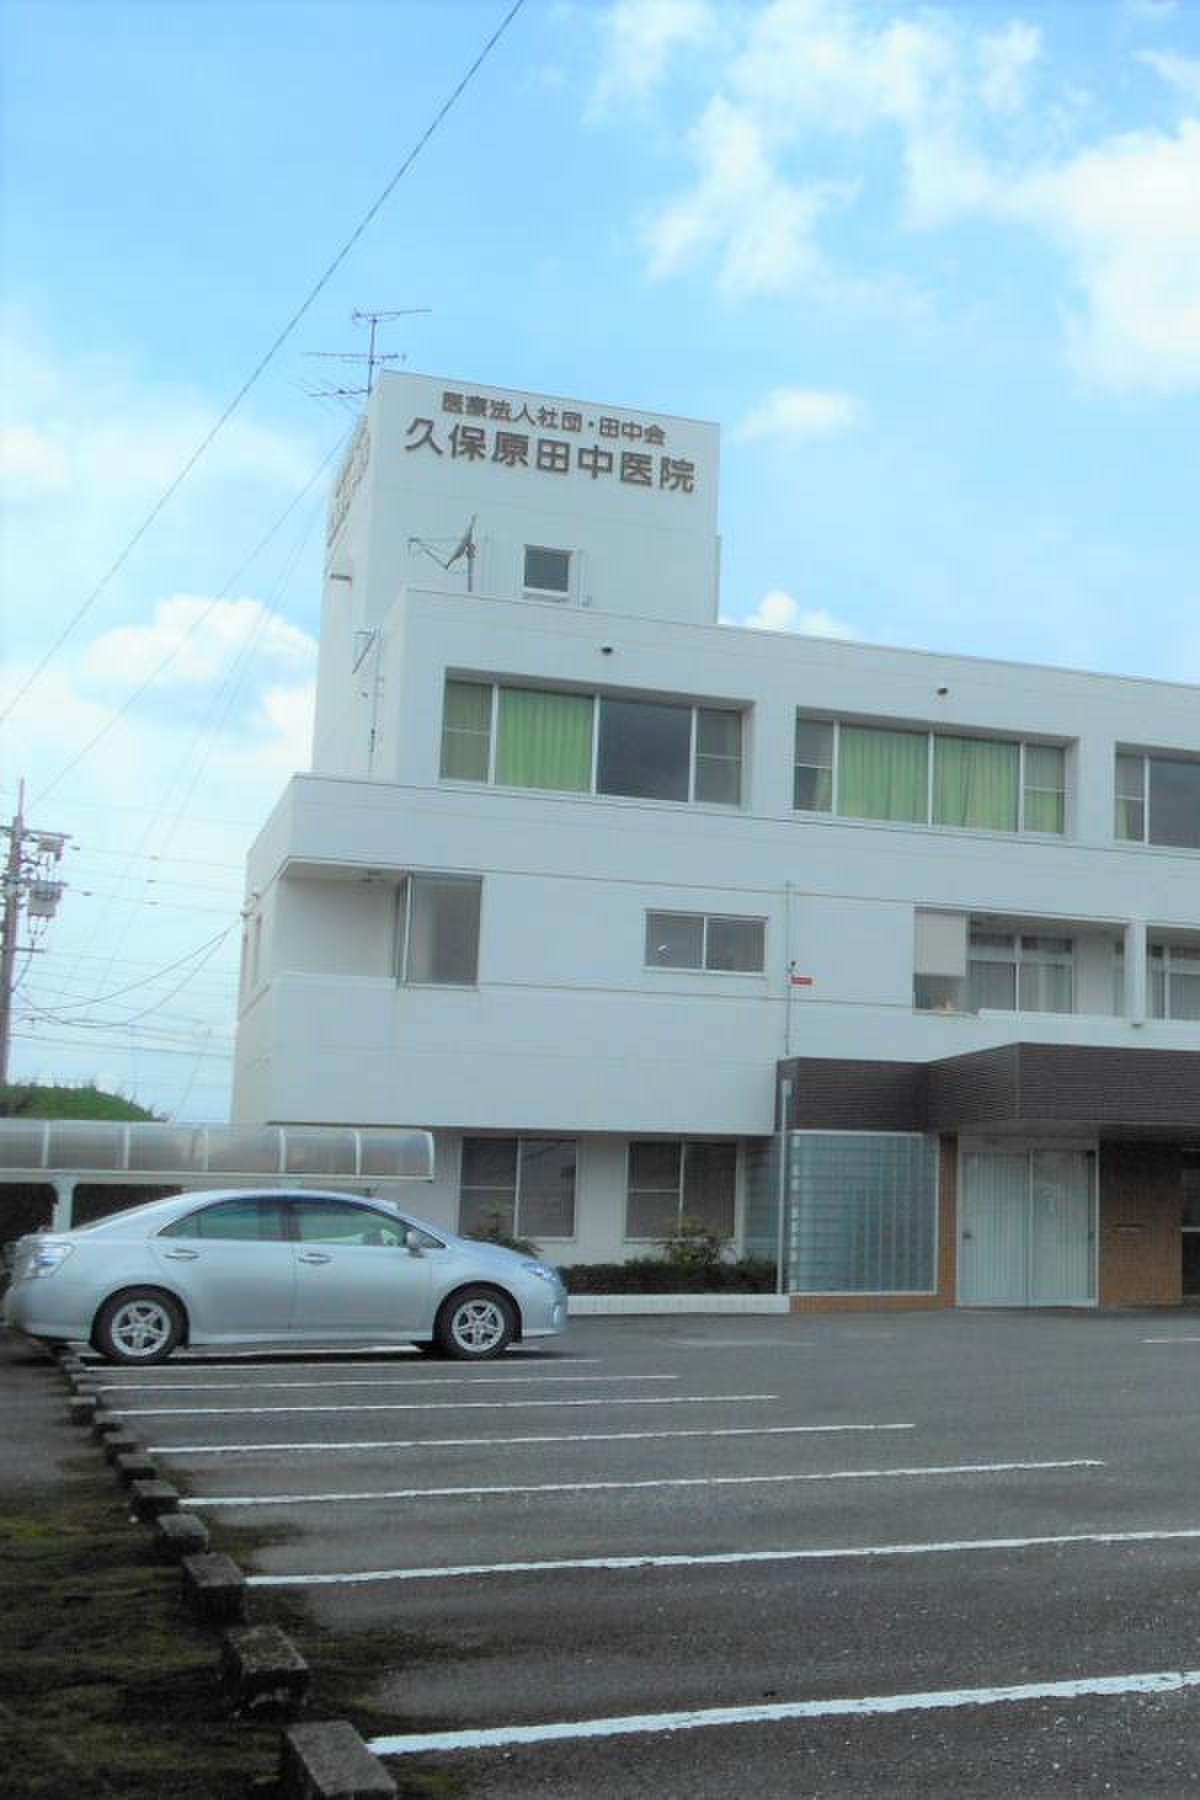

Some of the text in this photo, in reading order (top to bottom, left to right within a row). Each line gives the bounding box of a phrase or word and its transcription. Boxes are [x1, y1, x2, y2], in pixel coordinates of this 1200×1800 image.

[405, 417, 695, 494] 久保原田中医院
